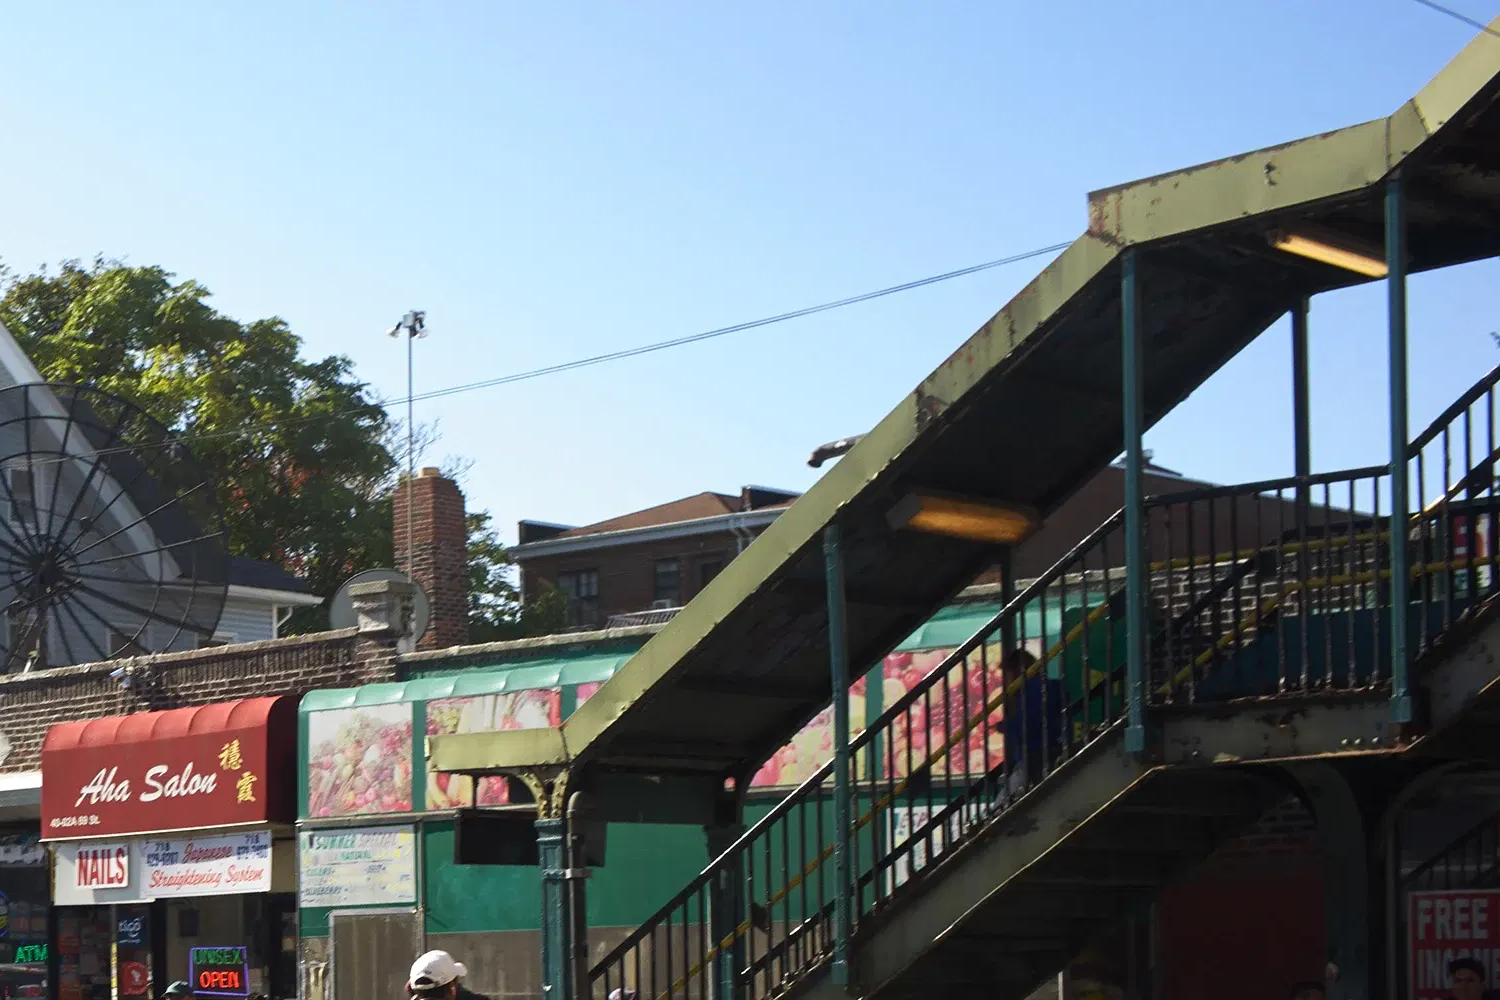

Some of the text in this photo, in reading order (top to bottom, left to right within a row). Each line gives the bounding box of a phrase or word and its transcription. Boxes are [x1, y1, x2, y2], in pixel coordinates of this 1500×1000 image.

[75, 761, 218, 807] Aha Salon
[182, 838, 233, 865] Japanese
[78, 847, 125, 887] NAILS
[149, 864, 264, 892] Straightening System
[1417, 897, 1489, 941] FREE
[14, 944, 48, 964] ATM
[193, 949, 244, 965] UNISEX
[200, 970, 240, 989] OPEN
